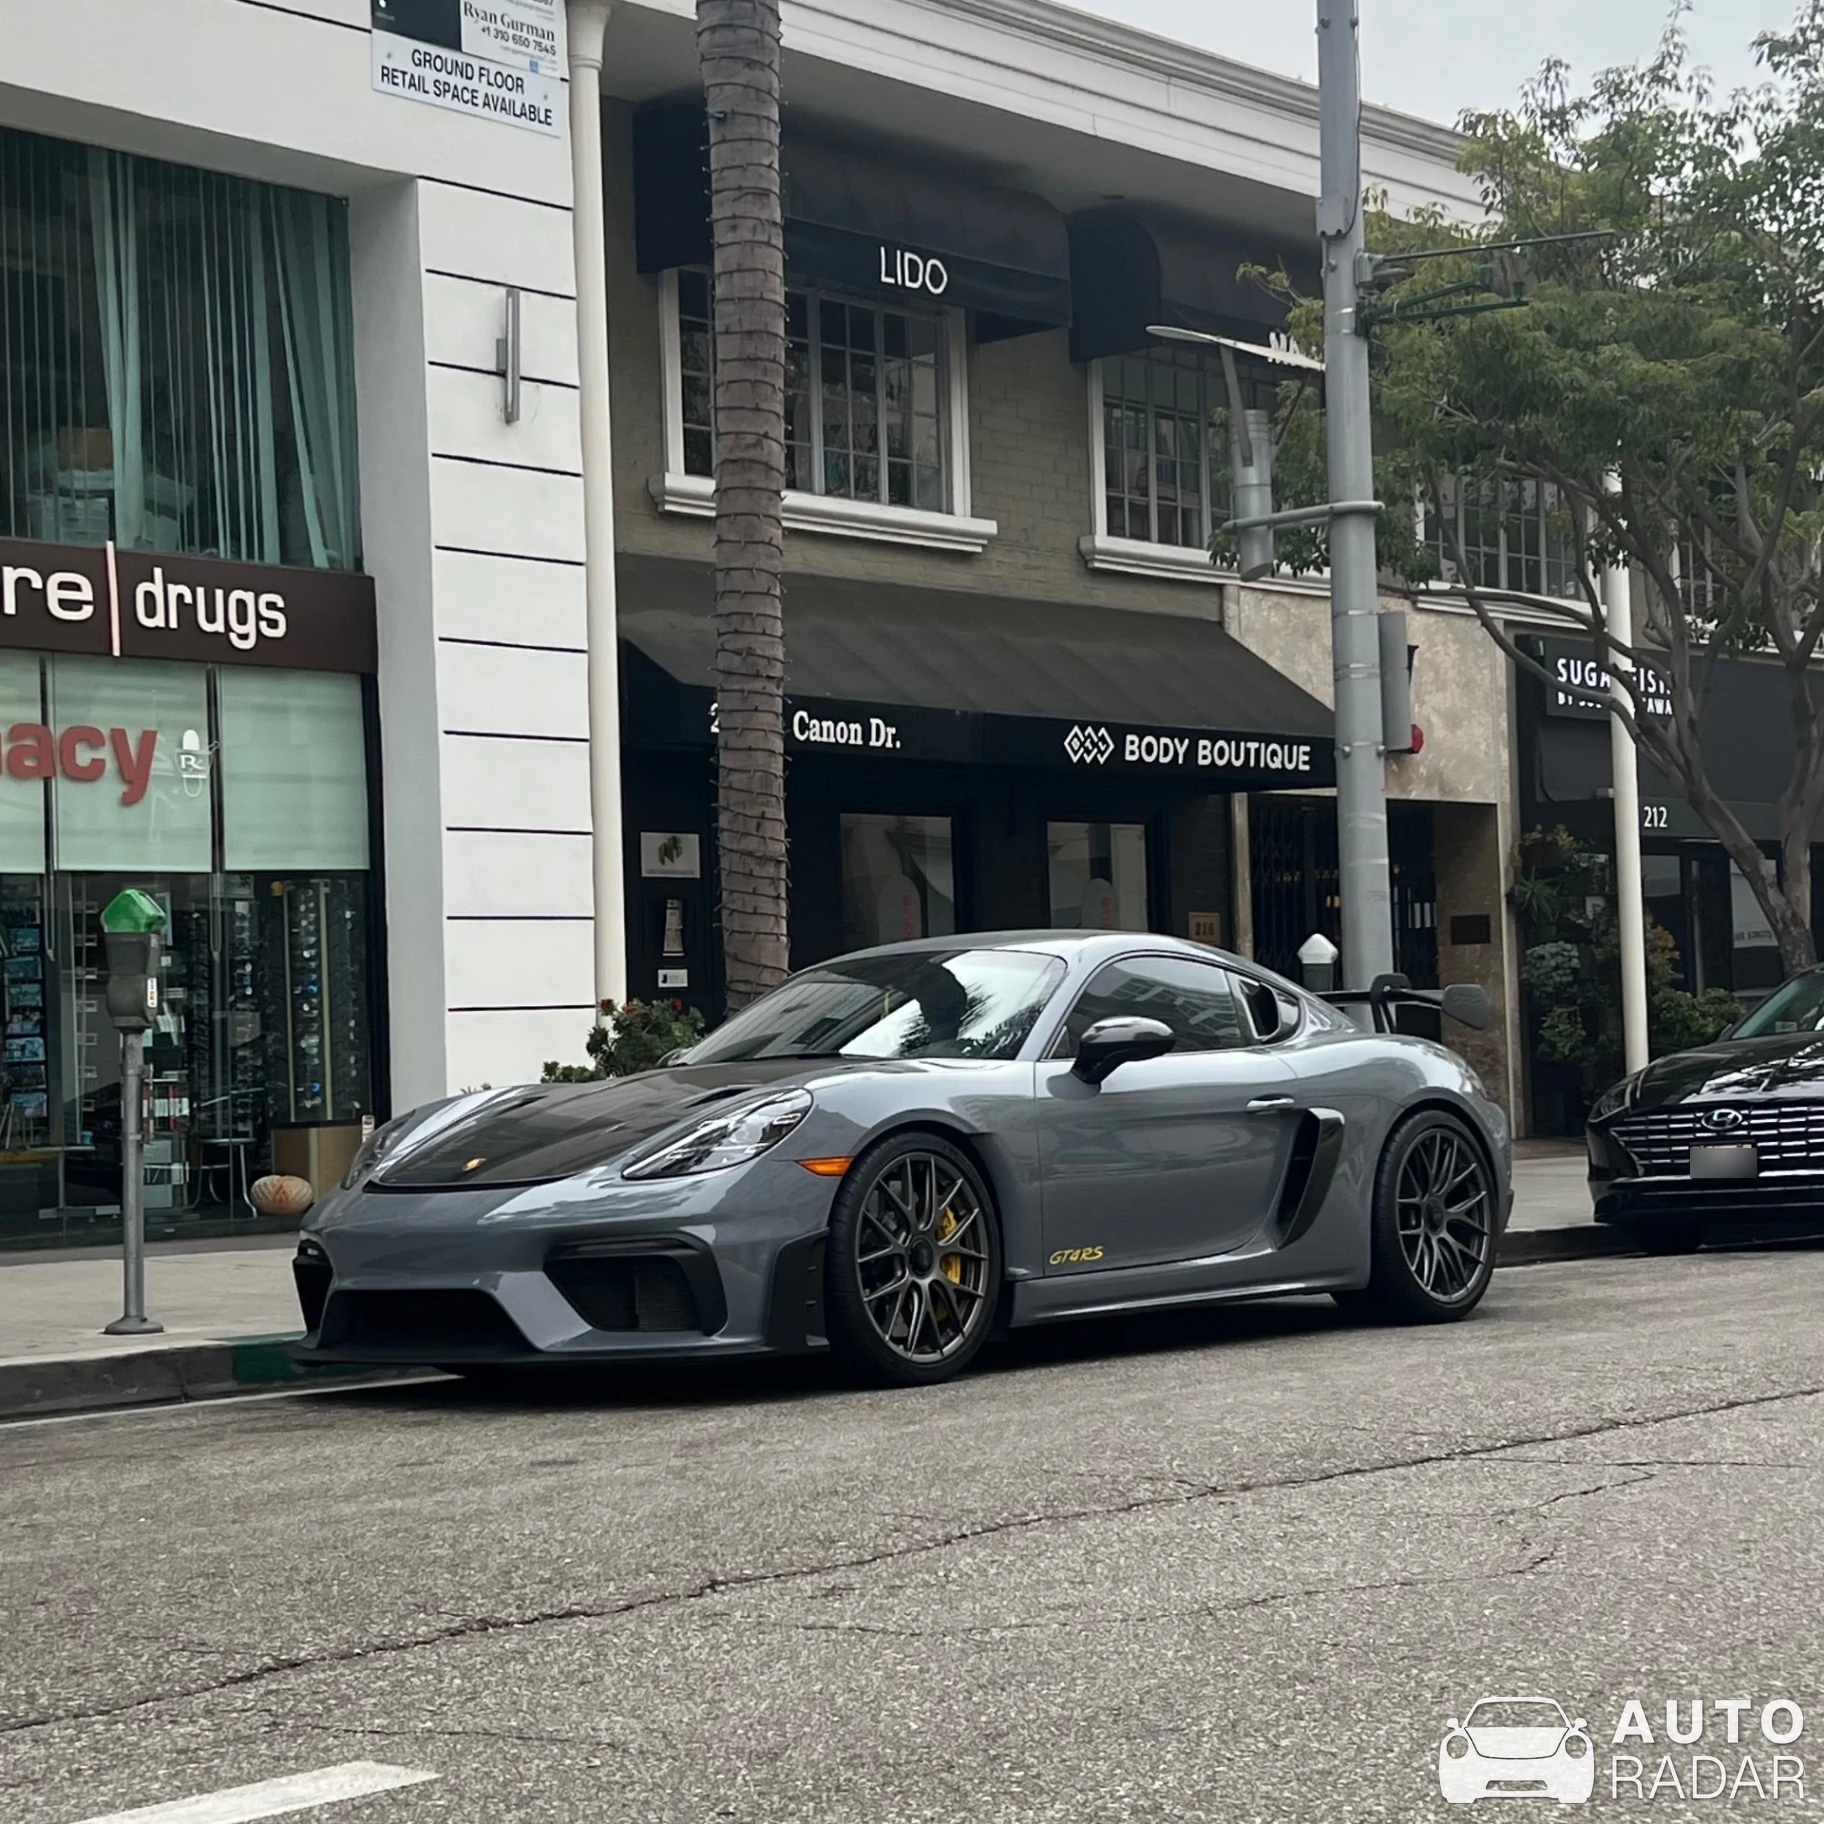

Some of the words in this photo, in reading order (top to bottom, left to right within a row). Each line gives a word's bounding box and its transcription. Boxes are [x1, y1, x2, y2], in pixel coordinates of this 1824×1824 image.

[464, 1, 497, 24] Ryan
[500, 13, 555, 42] Gurman
[481, 26, 491, 36] +1
[493, 29, 510, 42] 310
[511, 33, 530, 49] 650
[532, 39, 556, 56] 7545
[411, 49, 475, 81] GROUND
[479, 67, 525, 94] FLOOR
[381, 65, 430, 94] RETAIL
[433, 79, 479, 107] SPACE
[482, 92, 552, 126] AVAILABLE
[880, 246, 948, 294] LIDO
[135, 567, 287, 650] drugs
[793, 710, 863, 747] Canon
[869, 718, 901, 749] Dr.
[0, 722, 158, 806] acy
[1124, 734, 1190, 765] BODY
[1197, 739, 1311, 771] BOUTIQUE
[1643, 805, 1668, 828] 212
